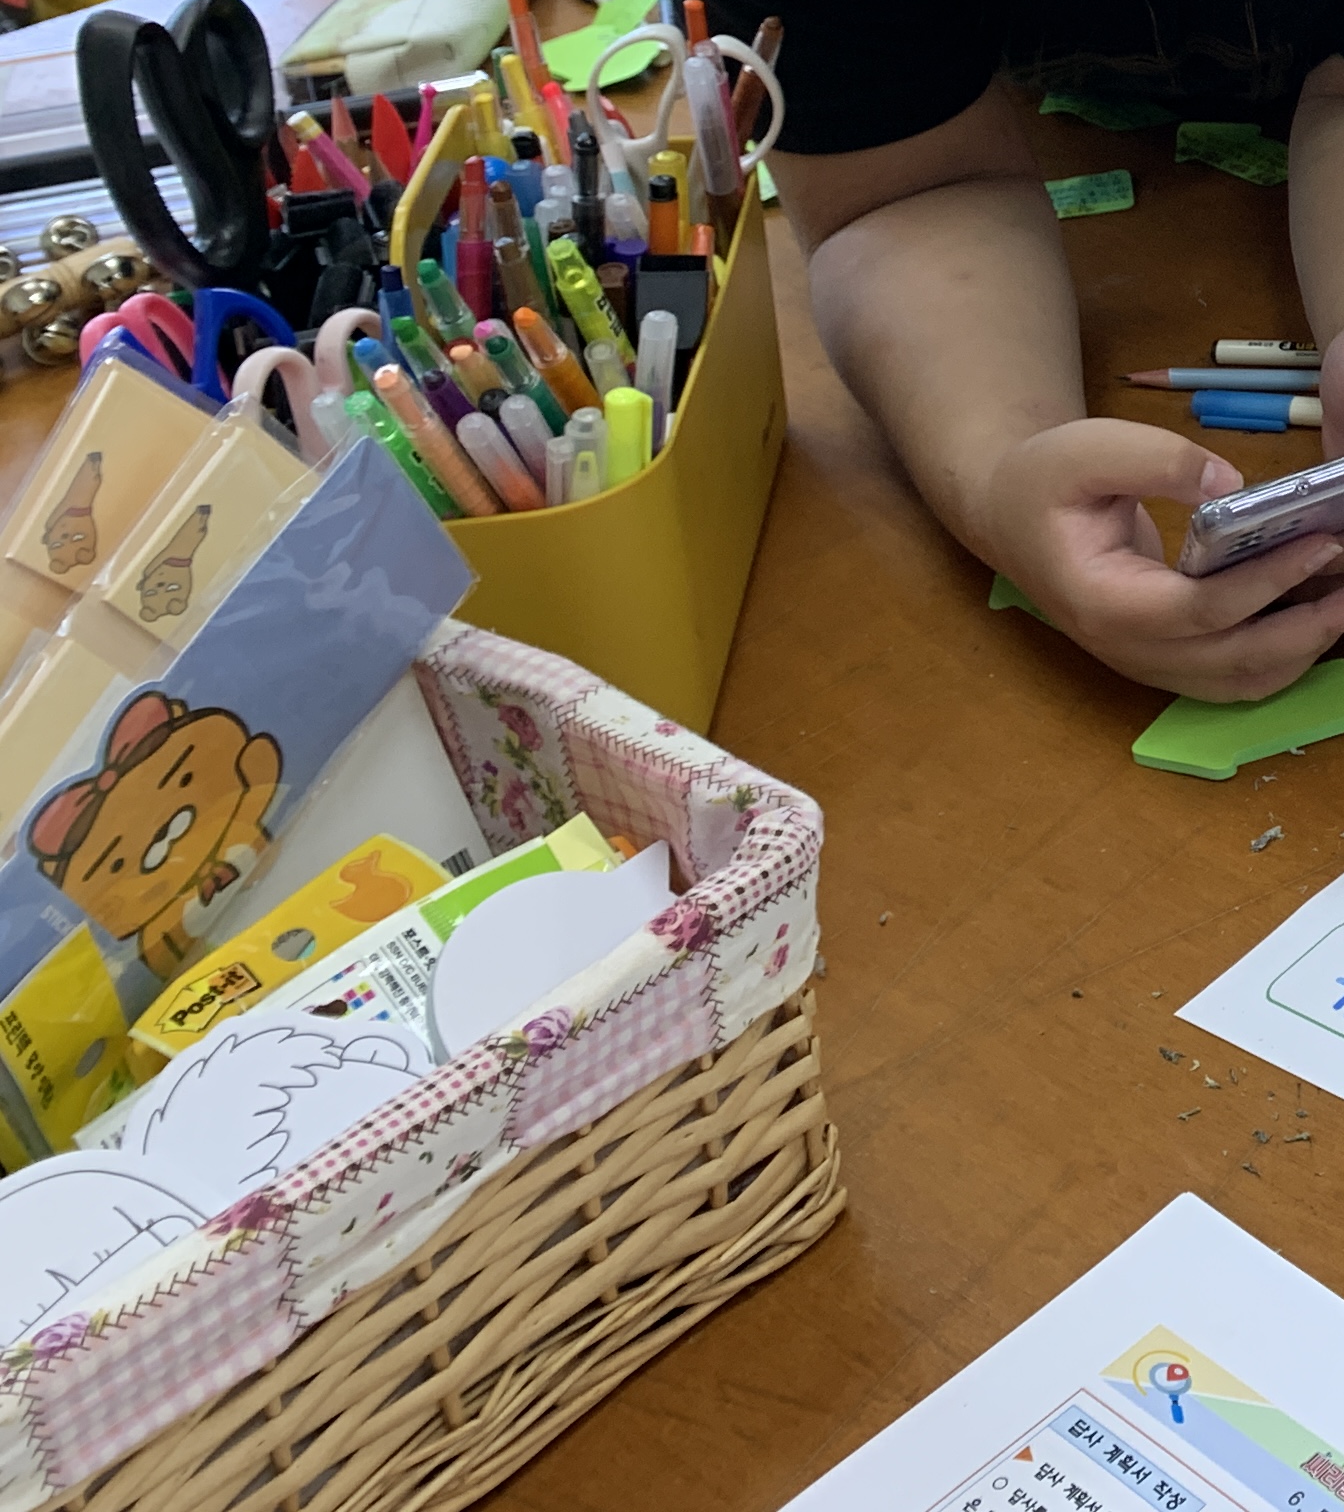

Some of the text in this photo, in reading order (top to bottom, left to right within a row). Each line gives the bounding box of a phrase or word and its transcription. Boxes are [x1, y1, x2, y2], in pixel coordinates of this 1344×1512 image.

[171, 968, 249, 1028] Post-it
[1033, 1462, 1065, 1487] 답사
[1067, 1418, 1186, 1512] 답사 계획서 작성
